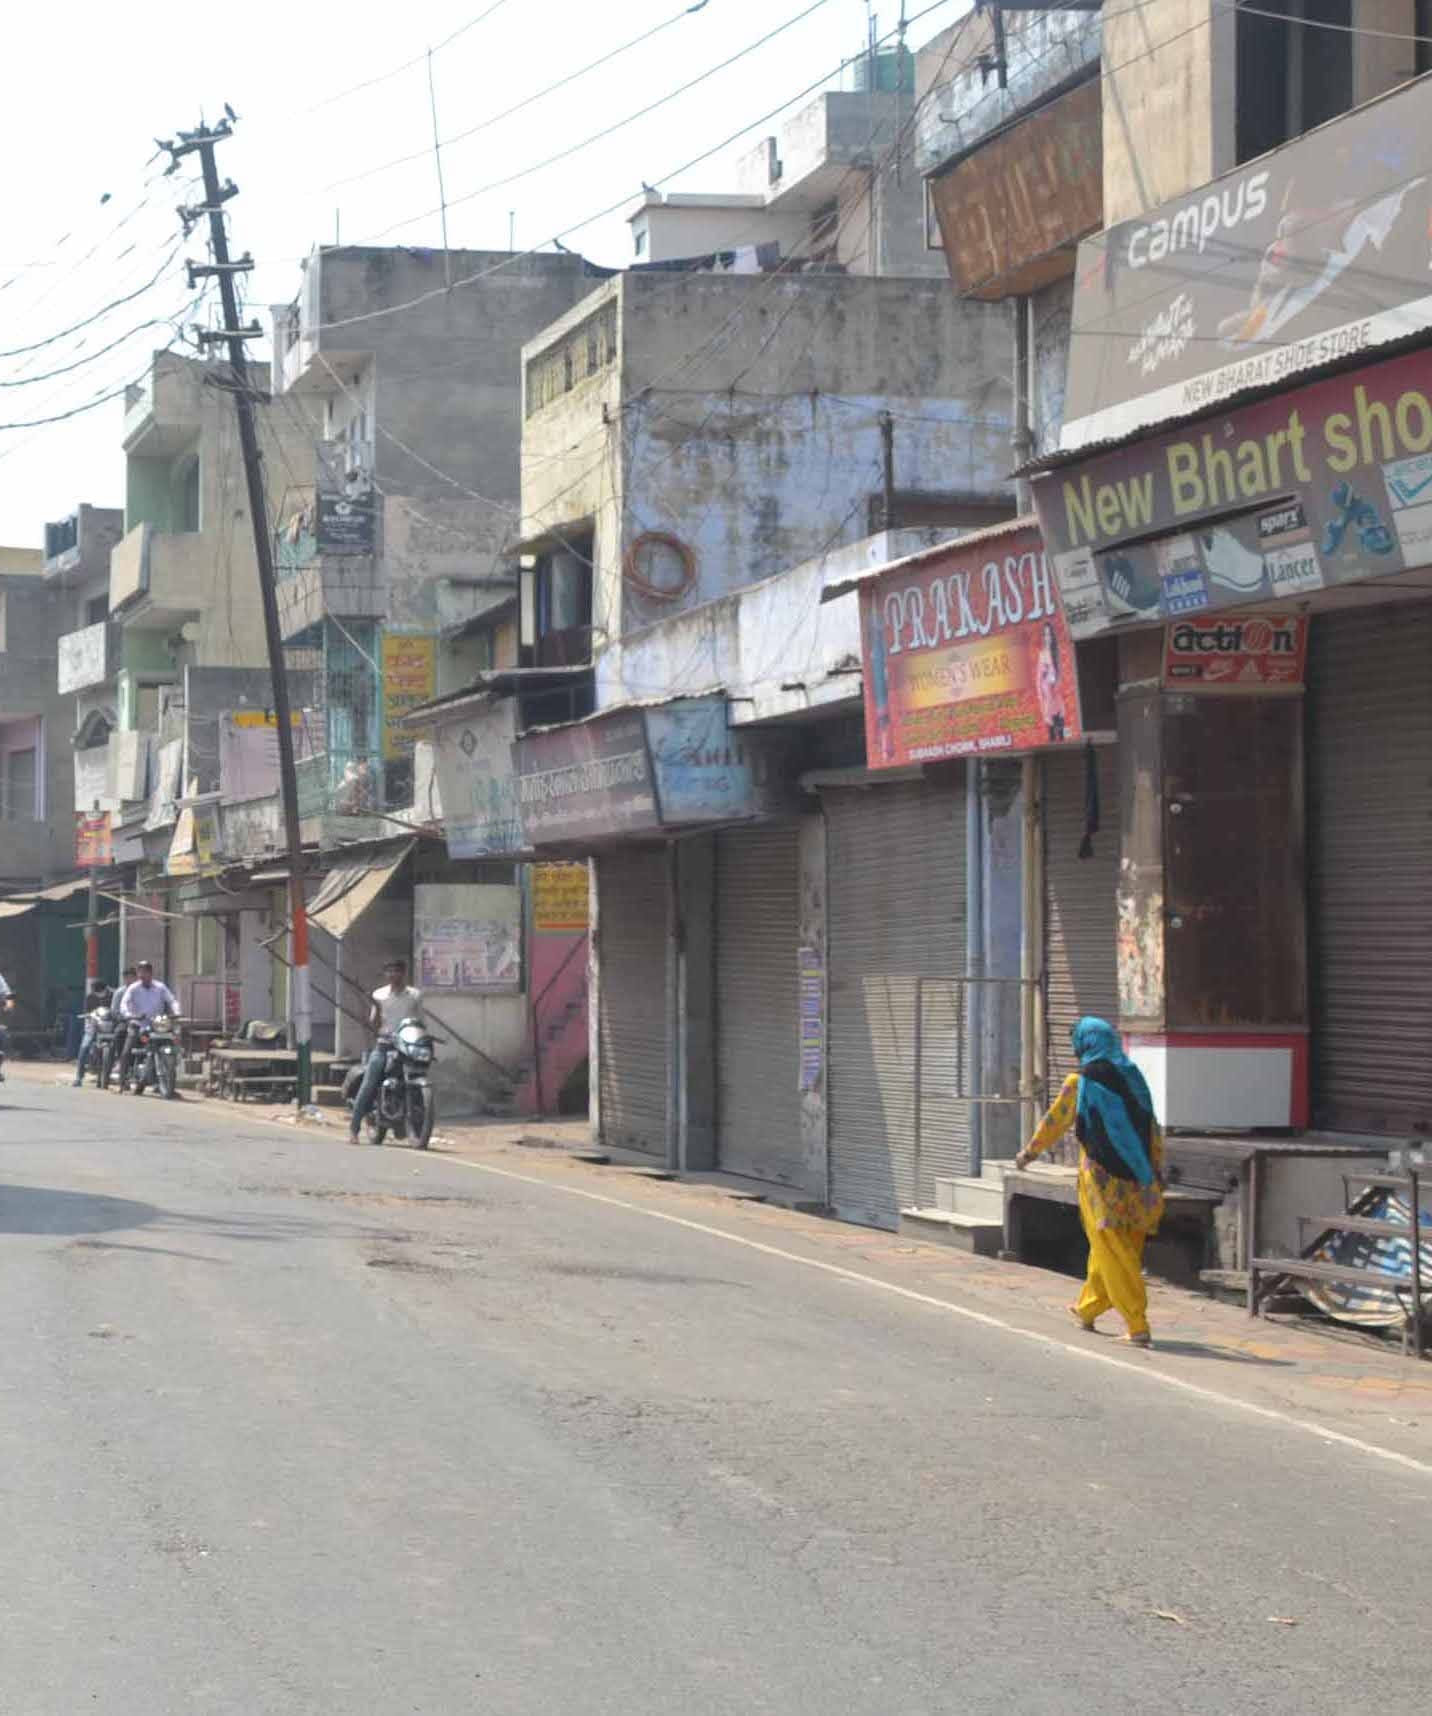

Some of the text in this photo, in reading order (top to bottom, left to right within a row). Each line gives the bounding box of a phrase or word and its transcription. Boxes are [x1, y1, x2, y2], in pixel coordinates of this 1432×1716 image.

[1127, 170, 1270, 269] campus
[1183, 323, 1372, 402] NEW BHARAT SHOE STORE
[1062, 472, 1155, 546] New
[1166, 409, 1312, 517] Bhart
[884, 552, 1055, 655] PRAKASH
[1269, 557, 1316, 584] Lancer
[970, 653, 1011, 681] WEAR
[1172, 619, 1296, 655] action
